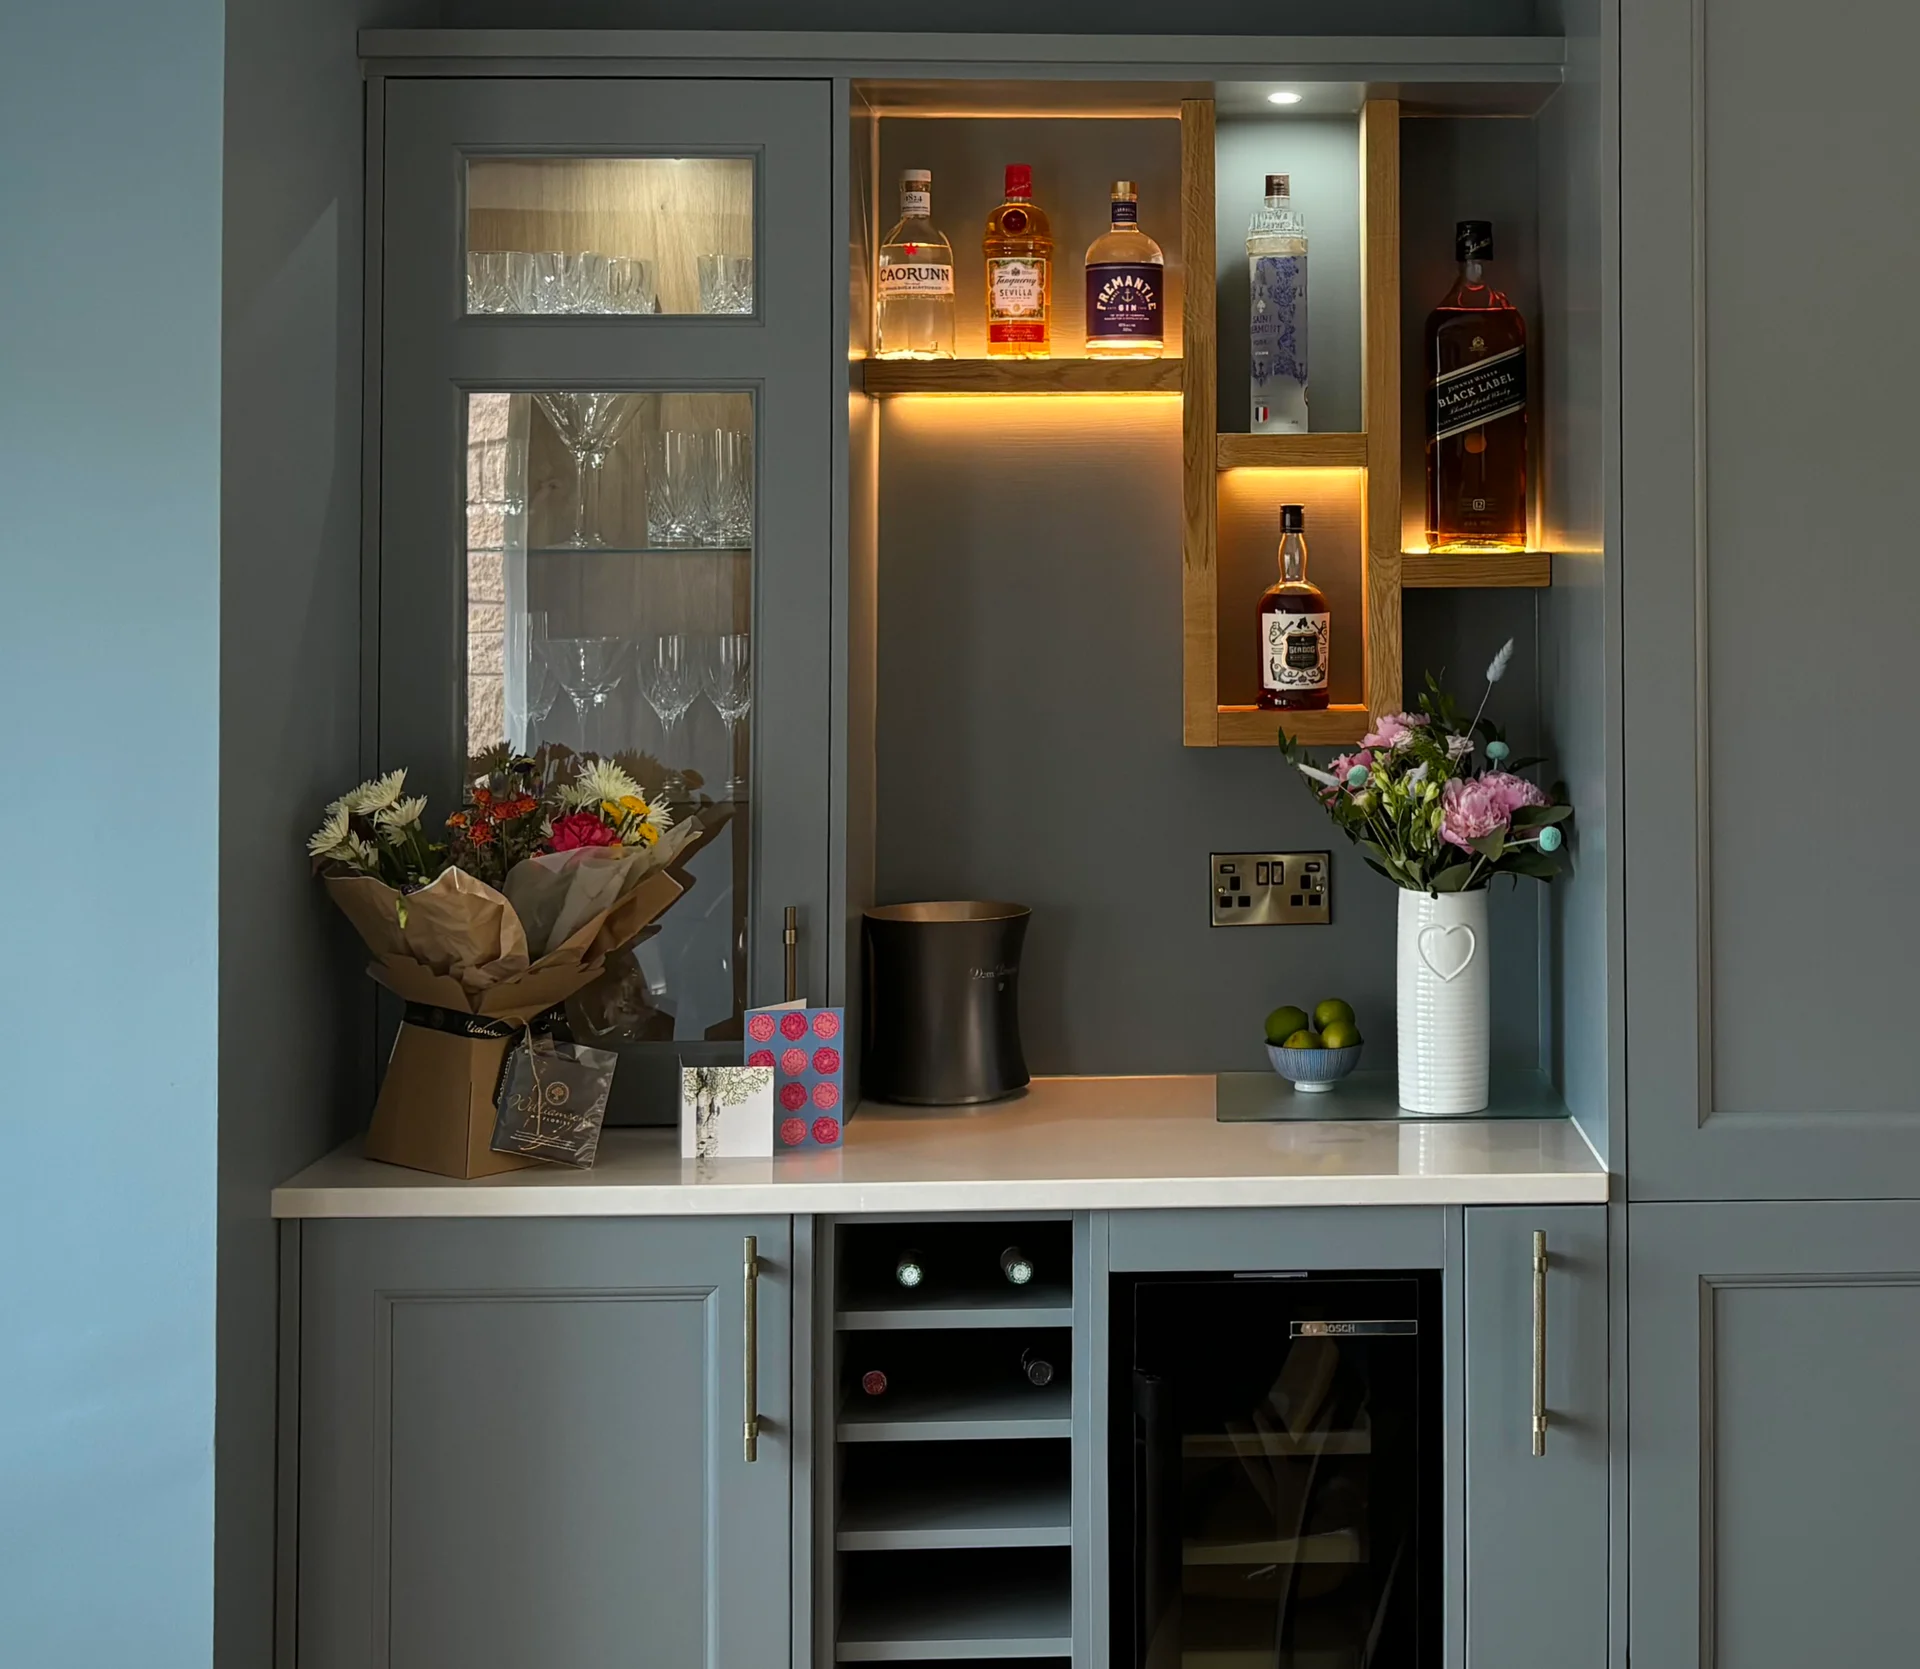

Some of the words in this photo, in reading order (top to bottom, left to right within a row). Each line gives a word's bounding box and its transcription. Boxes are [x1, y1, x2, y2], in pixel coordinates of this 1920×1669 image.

[880, 267, 949, 282] CAORUNN
[996, 275, 1037, 286] Tanqueray
[999, 288, 1033, 297] SEVILLA
[1096, 275, 1157, 311] FREMANTLE
[1118, 303, 1137, 312] GIN
[1438, 387, 1476, 408] BLACK
[1478, 373, 1515, 393] LABEL
[1475, 501, 1483, 509] 12
[969, 967, 995, 980] Dom
[1322, 1323, 1355, 1333] BOSCH
